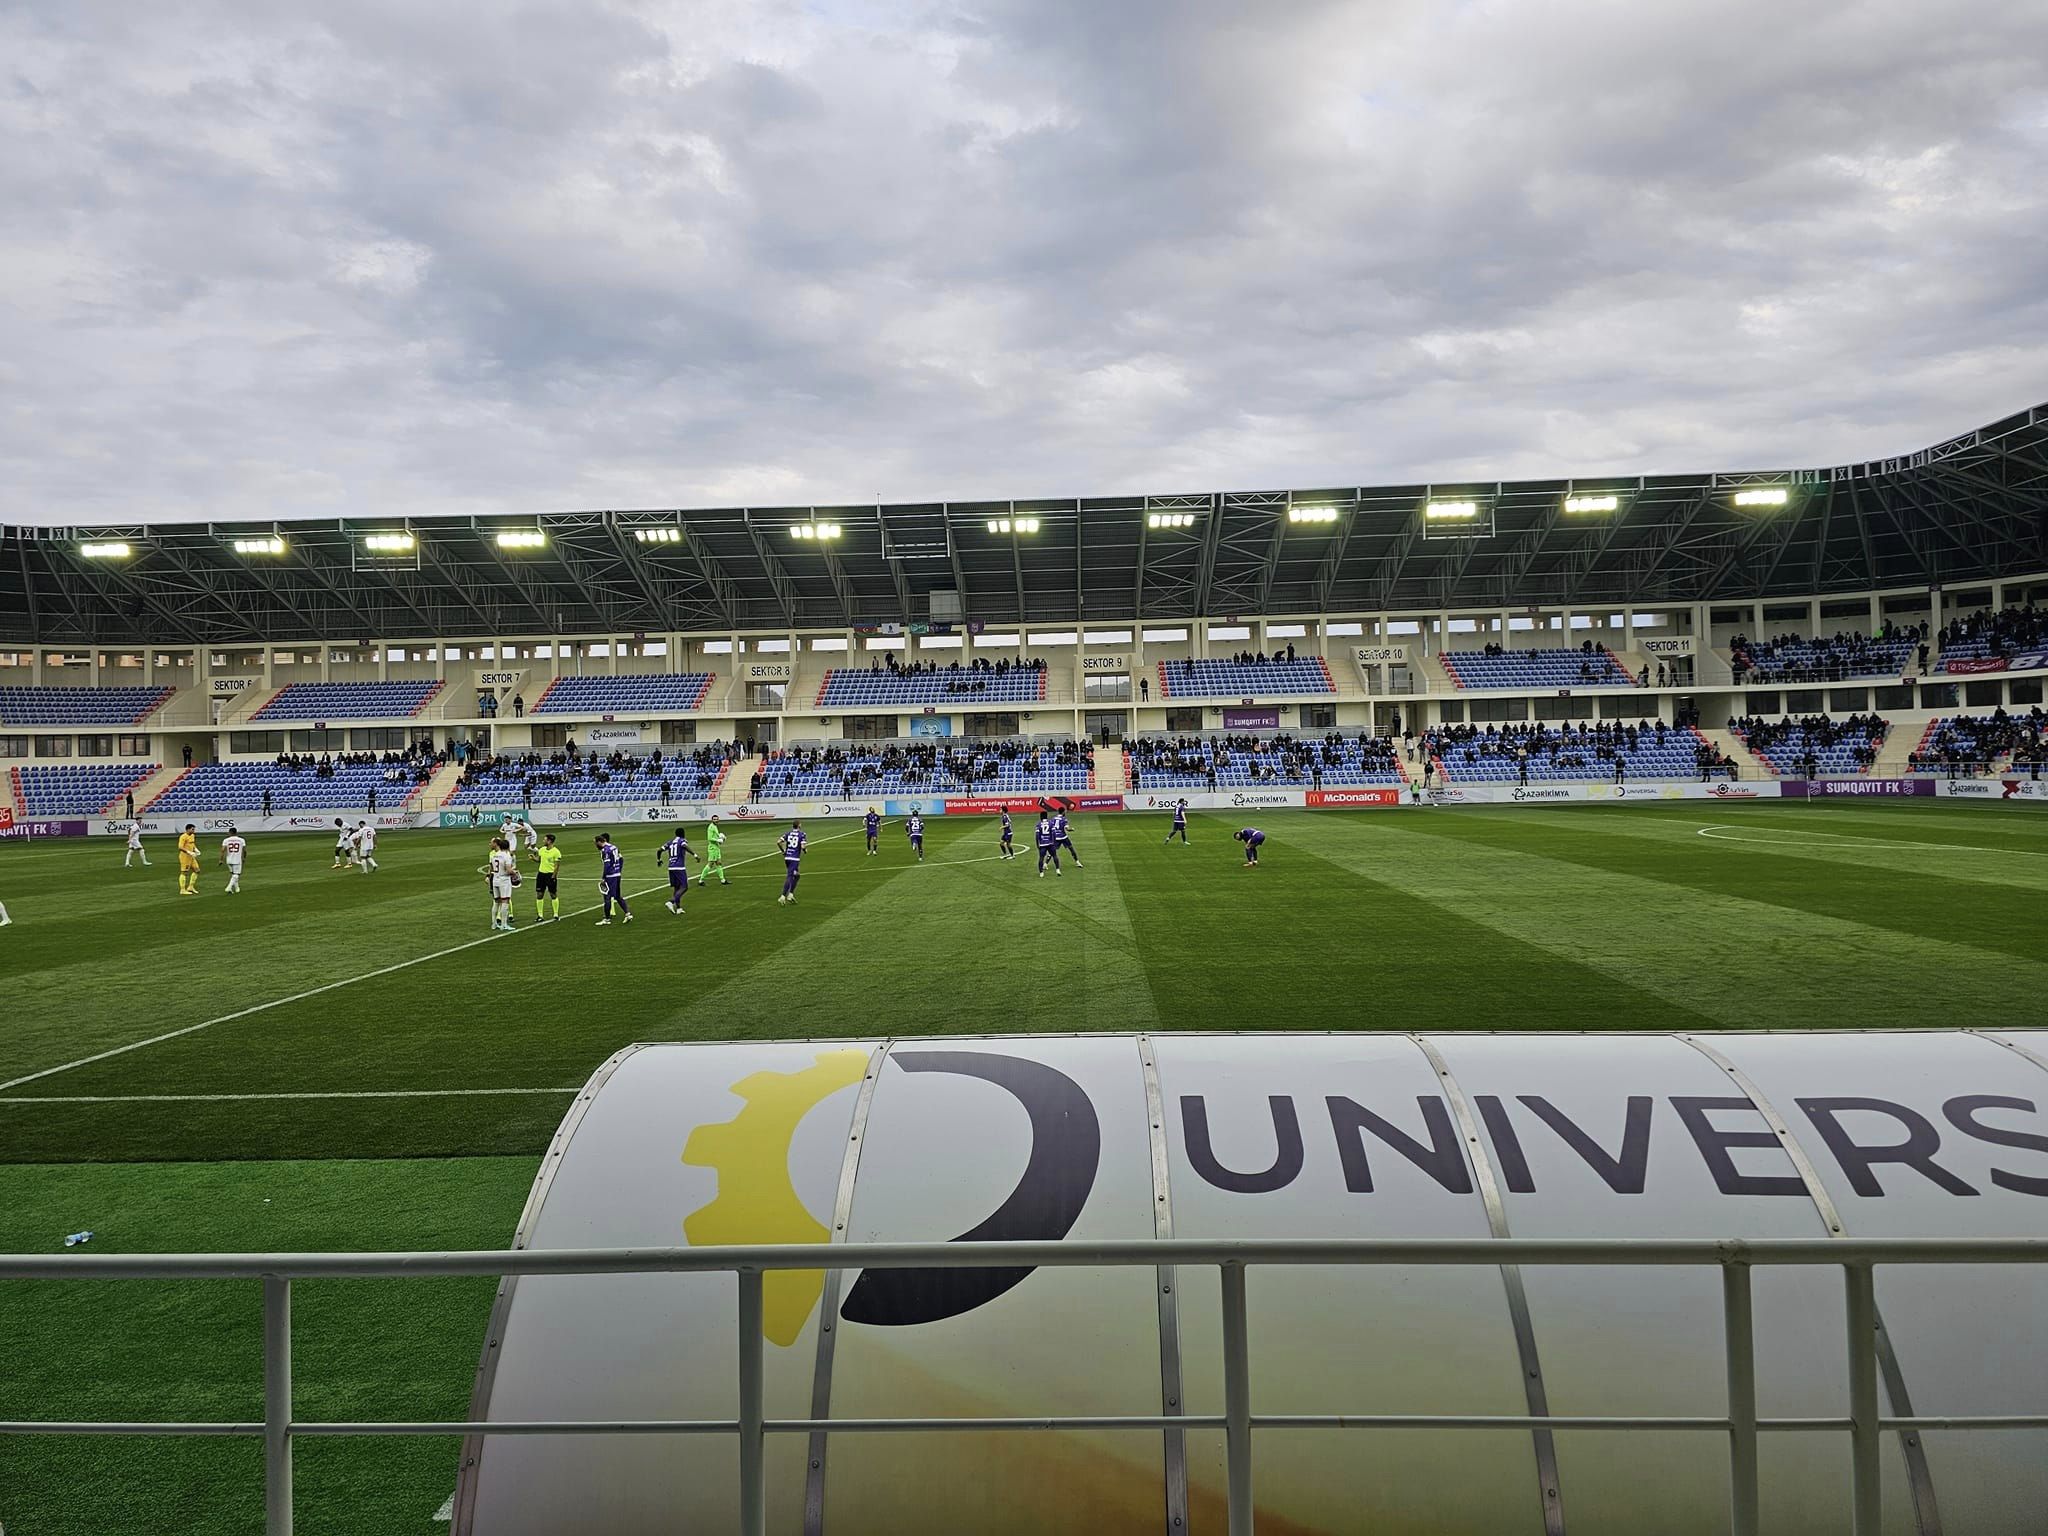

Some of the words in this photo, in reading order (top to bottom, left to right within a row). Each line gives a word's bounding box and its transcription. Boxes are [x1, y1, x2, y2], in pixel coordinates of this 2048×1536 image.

[1645, 641, 1679, 651] SEKTOR
[1681, 640, 1690, 650] 11
[1359, 649, 1391, 660] SEKTOR
[1393, 649, 1402, 659] 10
[1083, 658, 1114, 668] SEKTOR
[1116, 657, 1122, 667] 9
[751, 666, 782, 677] SEKTOR
[481, 673, 512, 684] SEKTOR
[515, 672, 520, 681] 7
[214, 680, 245, 690] SEKTOR
[1826, 782, 1882, 794] SUMQAYIT
[1886, 782, 1900, 793] FK
[1324, 792, 1381, 802] McDonald's
[1158, 800, 1188, 808] SOCR
[568, 811, 589, 820] ICSS
[33, 824, 47, 834] FK
[214, 819, 234, 828] ICSS
[366, 830, 372, 840] 6
[787, 835, 799, 848] 58
[228, 843, 240, 853] 29
[669, 843, 678, 856] 11
[1180, 1095, 2048, 1197] UNIVERS
